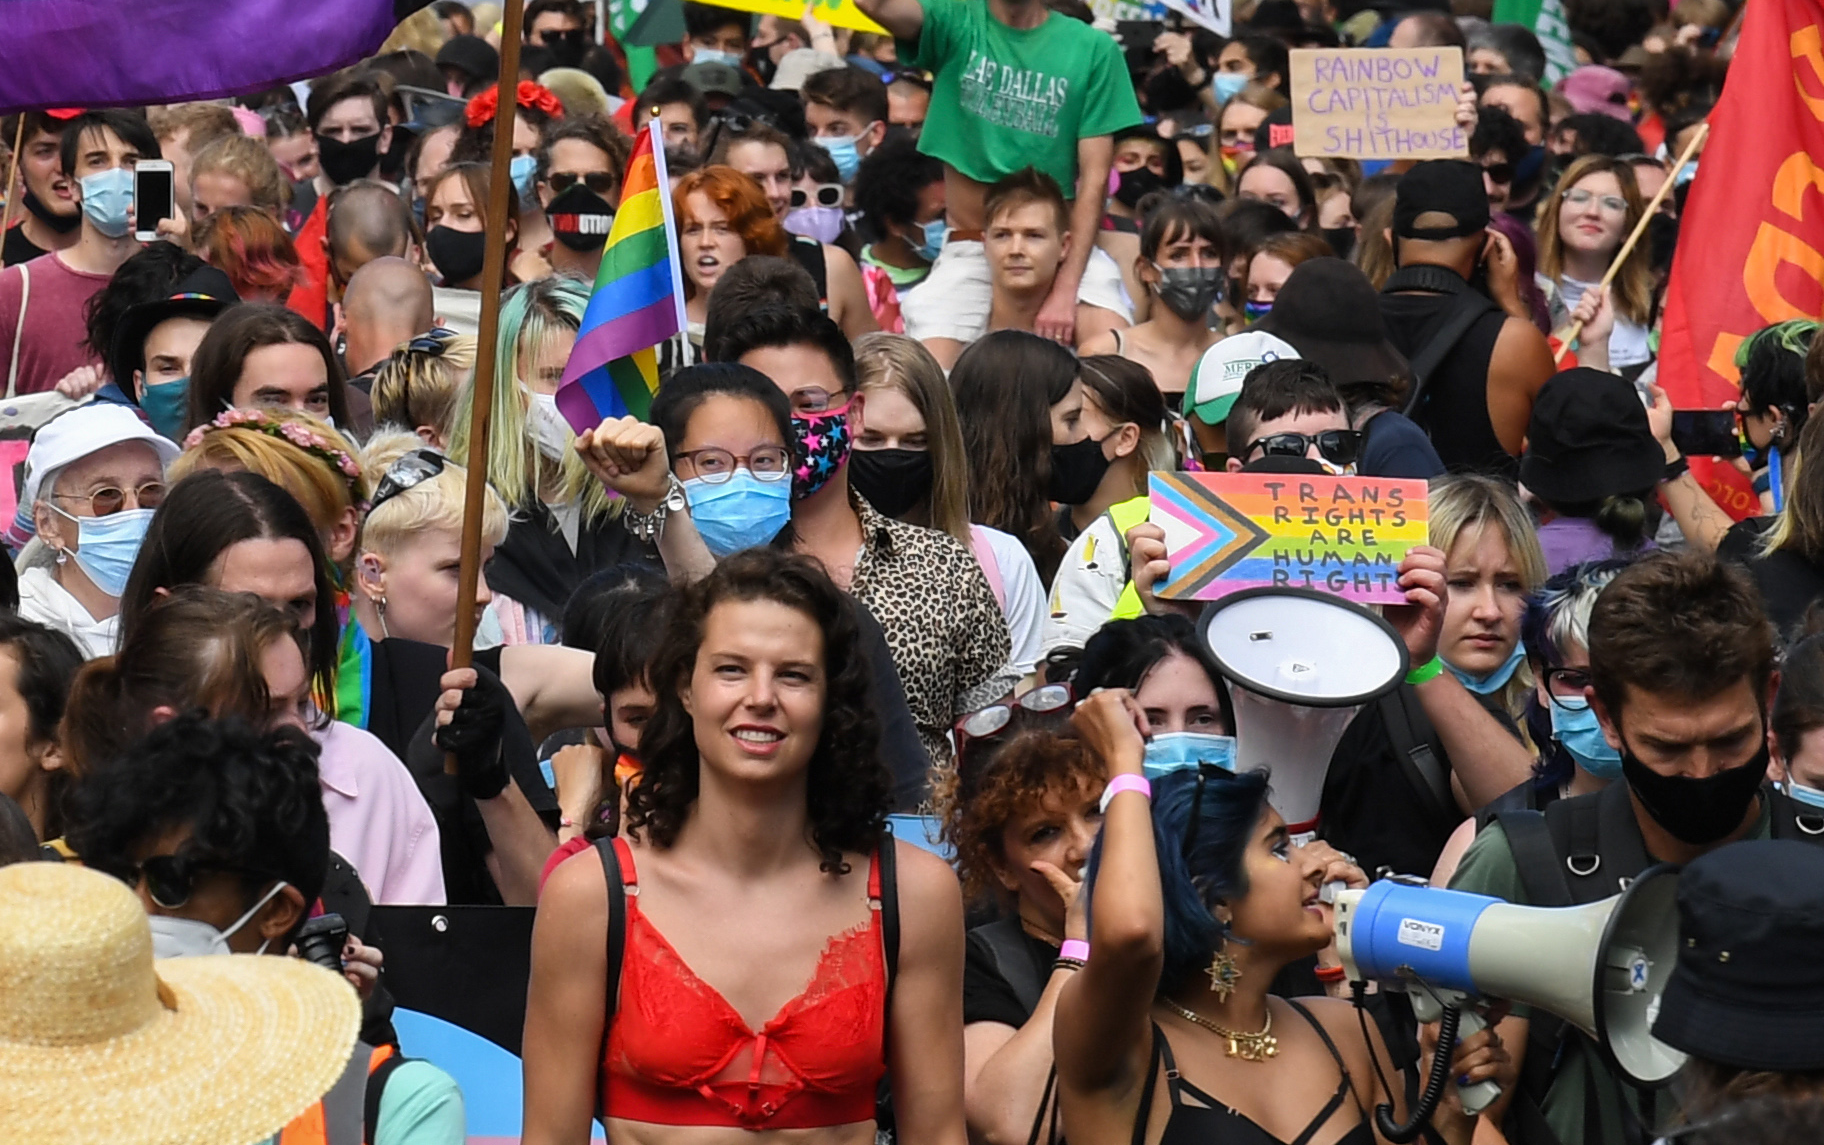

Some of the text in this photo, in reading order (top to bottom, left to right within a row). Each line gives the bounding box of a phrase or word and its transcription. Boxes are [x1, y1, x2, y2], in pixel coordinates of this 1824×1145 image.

[1314, 54, 1440, 84] RAINBOW
[998, 65, 1069, 109] DALLAS
[1307, 82, 1459, 114] CAPITALISM
[1365, 111, 1390, 135] IS
[1323, 125, 1466, 154] SHITHOUSE
[1264, 482, 1404, 507] TRANS
[1275, 505, 1407, 527] RIGHTS
[1310, 529, 1378, 547] ARE
[1273, 548, 1392, 567] HUMAN
[1272, 568, 1402, 593] RIGHT
